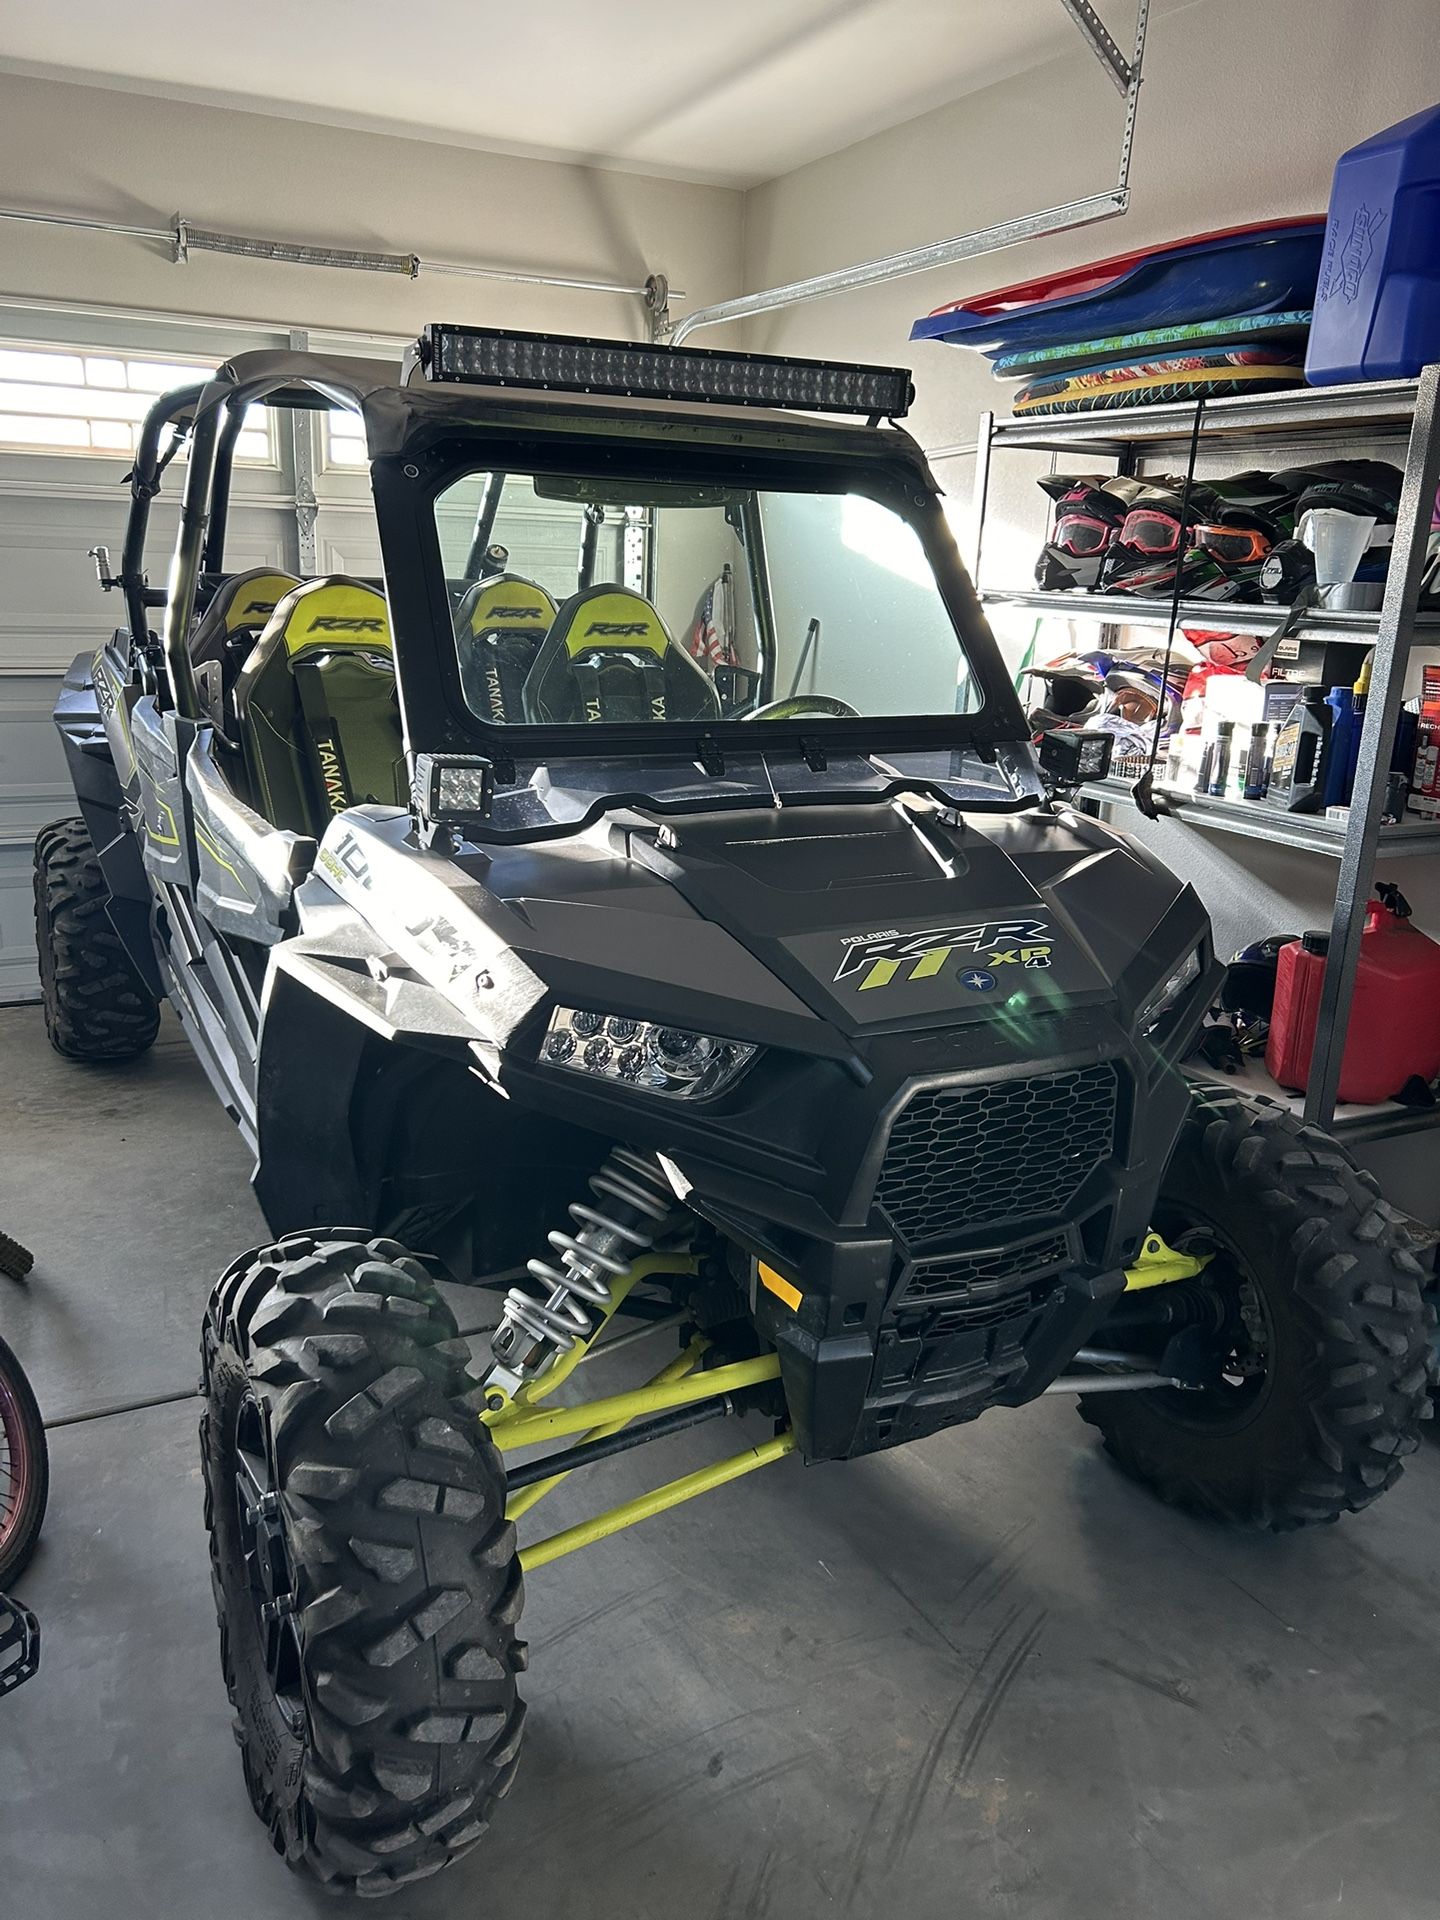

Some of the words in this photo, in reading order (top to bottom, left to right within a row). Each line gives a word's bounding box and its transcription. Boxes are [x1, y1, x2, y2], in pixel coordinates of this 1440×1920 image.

[1328, 219, 1340, 257] RACE
[1344, 211, 1368, 300] SUNOCO
[485, 606, 544, 620] RZR
[306, 615, 386, 633] RZR
[584, 622, 650, 637] RZR
[839, 929, 899, 946] POLARIS
[832, 919, 1056, 985] RZR
